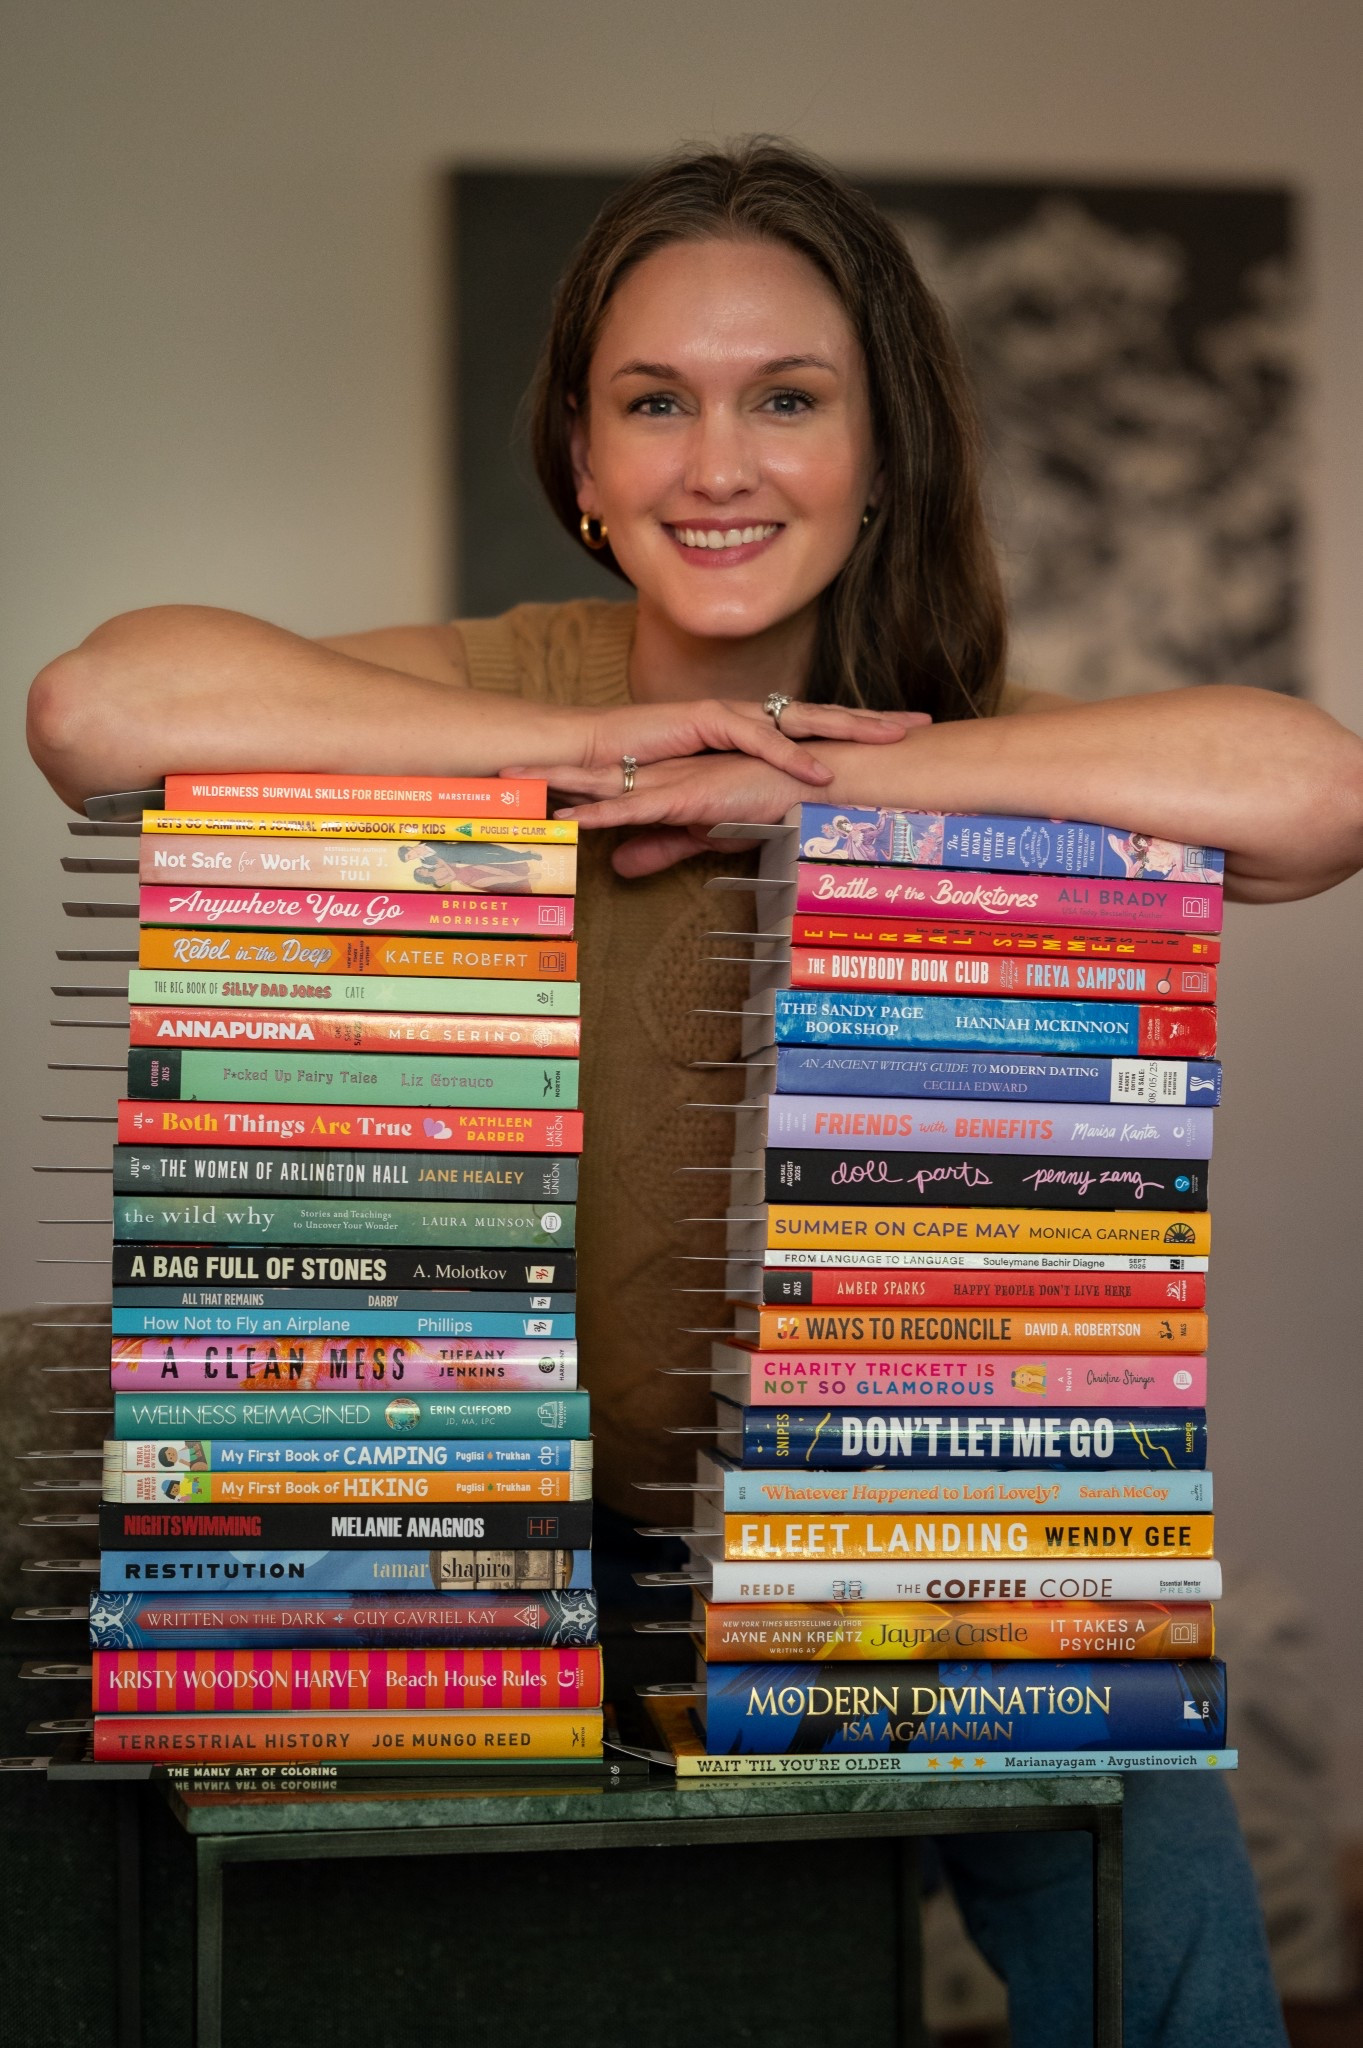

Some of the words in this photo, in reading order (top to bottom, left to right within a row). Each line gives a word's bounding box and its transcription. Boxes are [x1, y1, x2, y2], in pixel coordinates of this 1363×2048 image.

[192, 786, 259, 798] WILDERNESS
[262, 787, 313, 799] SURVIVAL
[315, 788, 349, 800] SKILLS
[351, 789, 371, 801] FOR
[373, 789, 432, 801] BEGINNERS
[438, 792, 491, 801] MARSTEINER
[1066, 828, 1075, 871] GOODMAN
[813, 874, 878, 901] Battle
[885, 884, 900, 901] of
[905, 885, 925, 900] the
[930, 879, 1038, 915] Bookstores
[1058, 888, 1088, 905] ALI
[1099, 890, 1167, 907] BRADY
[170, 890, 302, 919] Anywhere
[306, 894, 361, 923] You
[362, 896, 403, 925] Go
[442, 900, 508, 910] BRIDGET
[429, 915, 519, 926] MORRISSEY
[386, 951, 446, 965] KATEE
[452, 952, 527, 967] ROBERT
[1026, 964, 1071, 988] FREYA
[1077, 966, 1146, 991] SAMPSON
[781, 1002, 818, 1017] THE
[821, 1004, 877, 1018] SANDY
[880, 1006, 923, 1019] PAGE
[157, 1019, 314, 1040] ANNAPURNA
[805, 1021, 899, 1036] BOOKSHOP
[956, 1016, 1030, 1032] HANNAH
[1035, 1019, 1129, 1034] MCKINNON
[388, 1029, 430, 1040] MEG
[443, 1030, 522, 1042] SERINO
[151, 1060, 159, 1087] OCTOBER
[162, 1067, 170, 1081] 2025
[799, 1060, 818, 1069] AN
[820, 1060, 877, 1071] ANCIENT
[929, 1062, 969, 1073] GUIDE
[971, 1063, 987, 1074] TO
[989, 1065, 1046, 1076] MODERN
[1049, 1065, 1099, 1078] DATING
[923, 1080, 972, 1092] CECILIA
[975, 1081, 1028, 1093] EDWARD
[459, 1116, 533, 1128] KATHLEEN
[815, 1112, 912, 1137] FRIENDS
[918, 1120, 948, 1134] with
[954, 1118, 1053, 1139] BENEFITS
[467, 1131, 525, 1142] BARBER
[1071, 1122, 1117, 1140] Marisa
[1120, 1124, 1160, 1141] Kanter
[418, 1168, 459, 1183] JANE
[463, 1170, 524, 1185] HEALEY
[831, 1160, 903, 1184] doll
[907, 1161, 993, 1192] parts
[1022, 1167, 1095, 1195] penny
[1099, 1169, 1165, 1198] zang
[423, 1217, 469, 1227] LAURA
[474, 1218, 535, 1228] MUNSON
[1029, 1226, 1091, 1239] MONICA
[1095, 1227, 1160, 1241] GARNER
[130, 1256, 147, 1277] A
[152, 1256, 198, 1278] BAG
[206, 1256, 259, 1280] FULL
[266, 1257, 294, 1280] OF
[301, 1258, 387, 1281] STONES
[413, 1264, 432, 1278] A.
[436, 1263, 507, 1280] Molotkov
[983, 1258, 1039, 1268] Souleymane
[1042, 1258, 1071, 1268] Bachir
[1074, 1259, 1105, 1269] Diagne
[837, 1281, 879, 1295] AMBER
[883, 1282, 926, 1295] SPARKS
[182, 1293, 198, 1305] ALL
[200, 1294, 221, 1305] THAT
[223, 1294, 264, 1306] REMAINS
[368, 1296, 398, 1307] DARBY
[418, 1317, 473, 1333] Phillips
[1024, 1321, 1058, 1336] DAVID
[1060, 1322, 1072, 1336] A.
[1075, 1322, 1141, 1337] ROBERTSON
[765, 1362, 856, 1376] CHARITY
[866, 1363, 969, 1377] TRICKETT
[977, 1363, 995, 1377] IS
[765, 1381, 806, 1394] NOT
[818, 1381, 847, 1395] SO
[856, 1380, 995, 1395] GLAMOROUS
[131, 1405, 237, 1425] WELLNESS
[242, 1405, 370, 1425] REIMAGINED
[430, 1405, 456, 1416] ERIN
[460, 1406, 512, 1416] CLIFFORD
[777, 1413, 789, 1456] SNIPES
[841, 1417, 938, 1457] DON'T
[949, 1417, 1013, 1457] LET
[1014, 1418, 1062, 1457] ME
[1070, 1418, 1115, 1457] GO
[456, 1483, 484, 1494] Puglisi
[496, 1482, 531, 1492] Trukhan
[1079, 1487, 1120, 1499] Sarah
[1122, 1487, 1169, 1501] McCoy
[331, 1517, 402, 1538] MELANIE
[406, 1517, 485, 1538] ANAGNOS
[740, 1524, 850, 1553] FLEET
[866, 1523, 1029, 1553] LANDING
[1044, 1527, 1134, 1546] WENDY
[1145, 1527, 1191, 1546] GEE
[125, 1562, 305, 1579] RESTITUTION
[373, 1561, 429, 1578] tamar
[442, 1557, 511, 1582] shapiro
[740, 1584, 796, 1596] REEDE
[896, 1585, 921, 1595] THE
[926, 1580, 1026, 1599] COFFEE
[1040, 1579, 1113, 1598] CODE
[147, 1612, 225, 1625] WRITTEN
[230, 1614, 250, 1624] ON
[253, 1614, 277, 1625] THE
[281, 1612, 326, 1625] DARK
[353, 1611, 391, 1625] GUY
[394, 1611, 464, 1625] GAVRIEL
[466, 1611, 499, 1624] KAY
[870, 1627, 950, 1657] Jayne
[954, 1623, 1028, 1648] Castle
[109, 1670, 176, 1690] KRISTY
[183, 1670, 289, 1689] WOODSON
[295, 1669, 371, 1688] HARVEY
[386, 1669, 442, 1687] Beach
[444, 1670, 498, 1687] House
[502, 1669, 547, 1687] Rules
[746, 1687, 898, 1717] MODERN
[119, 1734, 257, 1749] TERRESTRIAL
[265, 1733, 351, 1749] HISTORY
[371, 1732, 409, 1748] JOE
[413, 1732, 480, 1747] MUNGO
[484, 1732, 531, 1747] REED
[842, 1722, 875, 1742] ISA
[880, 1721, 1013, 1745] AGAJANIAN
[697, 1760, 741, 1772] WAIT
[745, 1759, 776, 1772] 'TIL
[779, 1759, 840, 1771] YOU'RE
[845, 1758, 901, 1770] OLDER
[1005, 1756, 1097, 1770] Marianayagam
[1107, 1754, 1198, 1769] Avgustinovich
[167, 1767, 191, 1776] THE
[194, 1767, 231, 1776] MANLY
[235, 1767, 257, 1776] ART
[261, 1767, 277, 1776] OF
[280, 1766, 337, 1776] COLORING
